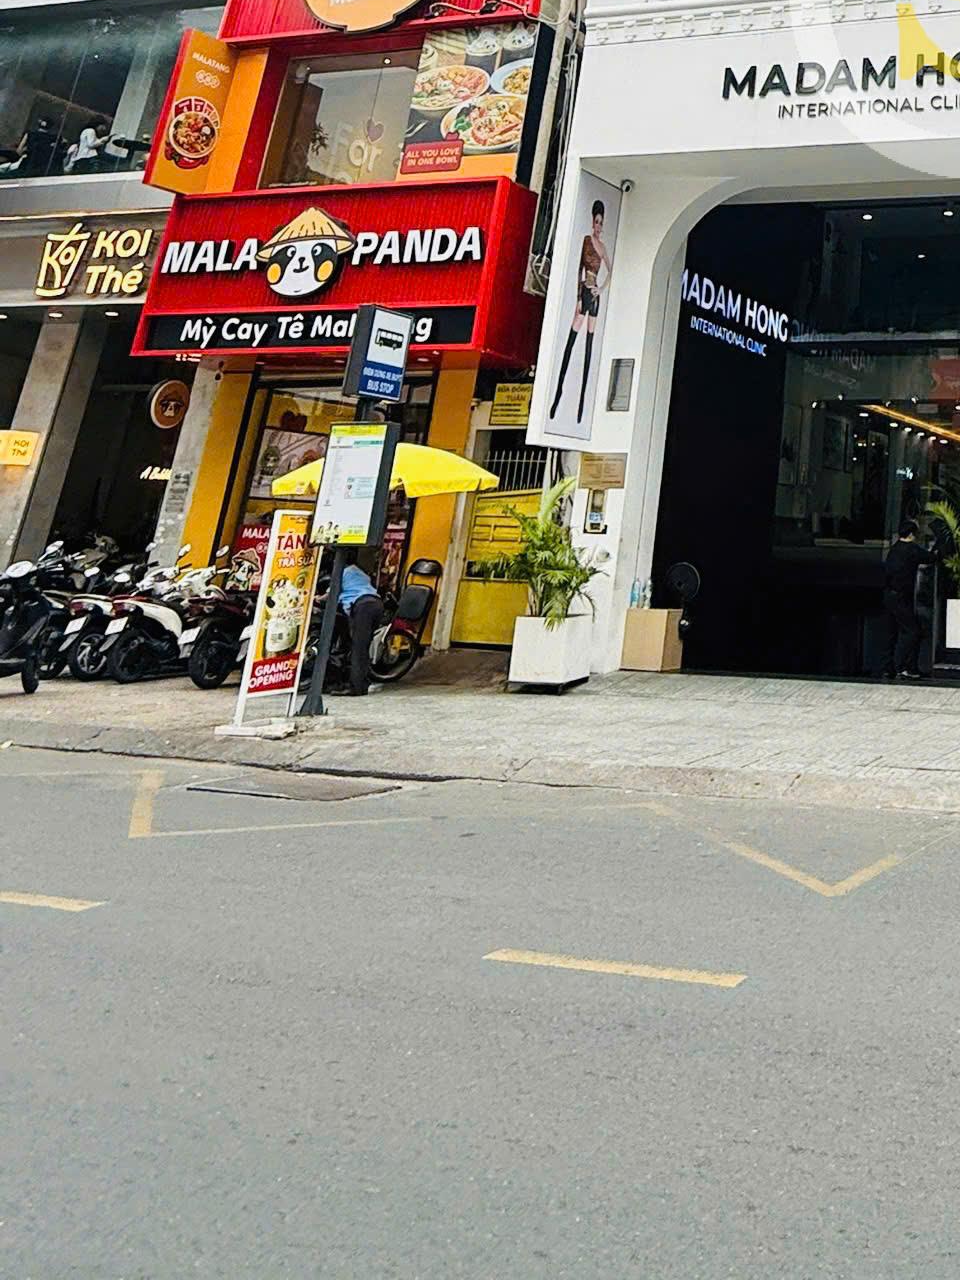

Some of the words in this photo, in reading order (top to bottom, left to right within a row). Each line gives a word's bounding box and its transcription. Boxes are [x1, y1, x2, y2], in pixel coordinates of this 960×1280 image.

[192, 52, 230, 73] MALATANG
[722, 55, 897, 100] MADAM
[778, 96, 924, 119] INTERNATIONAL
[422, 149, 439, 157] YOU
[92, 229, 153, 259] KOI
[161, 238, 258, 274] MALA
[352, 227, 483, 266] PANDA
[85, 262, 145, 294] Thé
[180, 316, 217, 349] Mỳ
[221, 318, 268, 348] Cay
[277, 314, 303, 339] Tê
[310, 313, 433, 343] Malg
[744, 298, 788, 342] HONG
[690, 315, 745, 349] INTERNATIONAL
[747, 338, 768, 357] CLINIC
[366, 379, 379, 392] BUS
[379, 381, 394, 394] STOP
[248, 670, 294, 689] OPENING
[254, 661, 290, 677] GRAND
